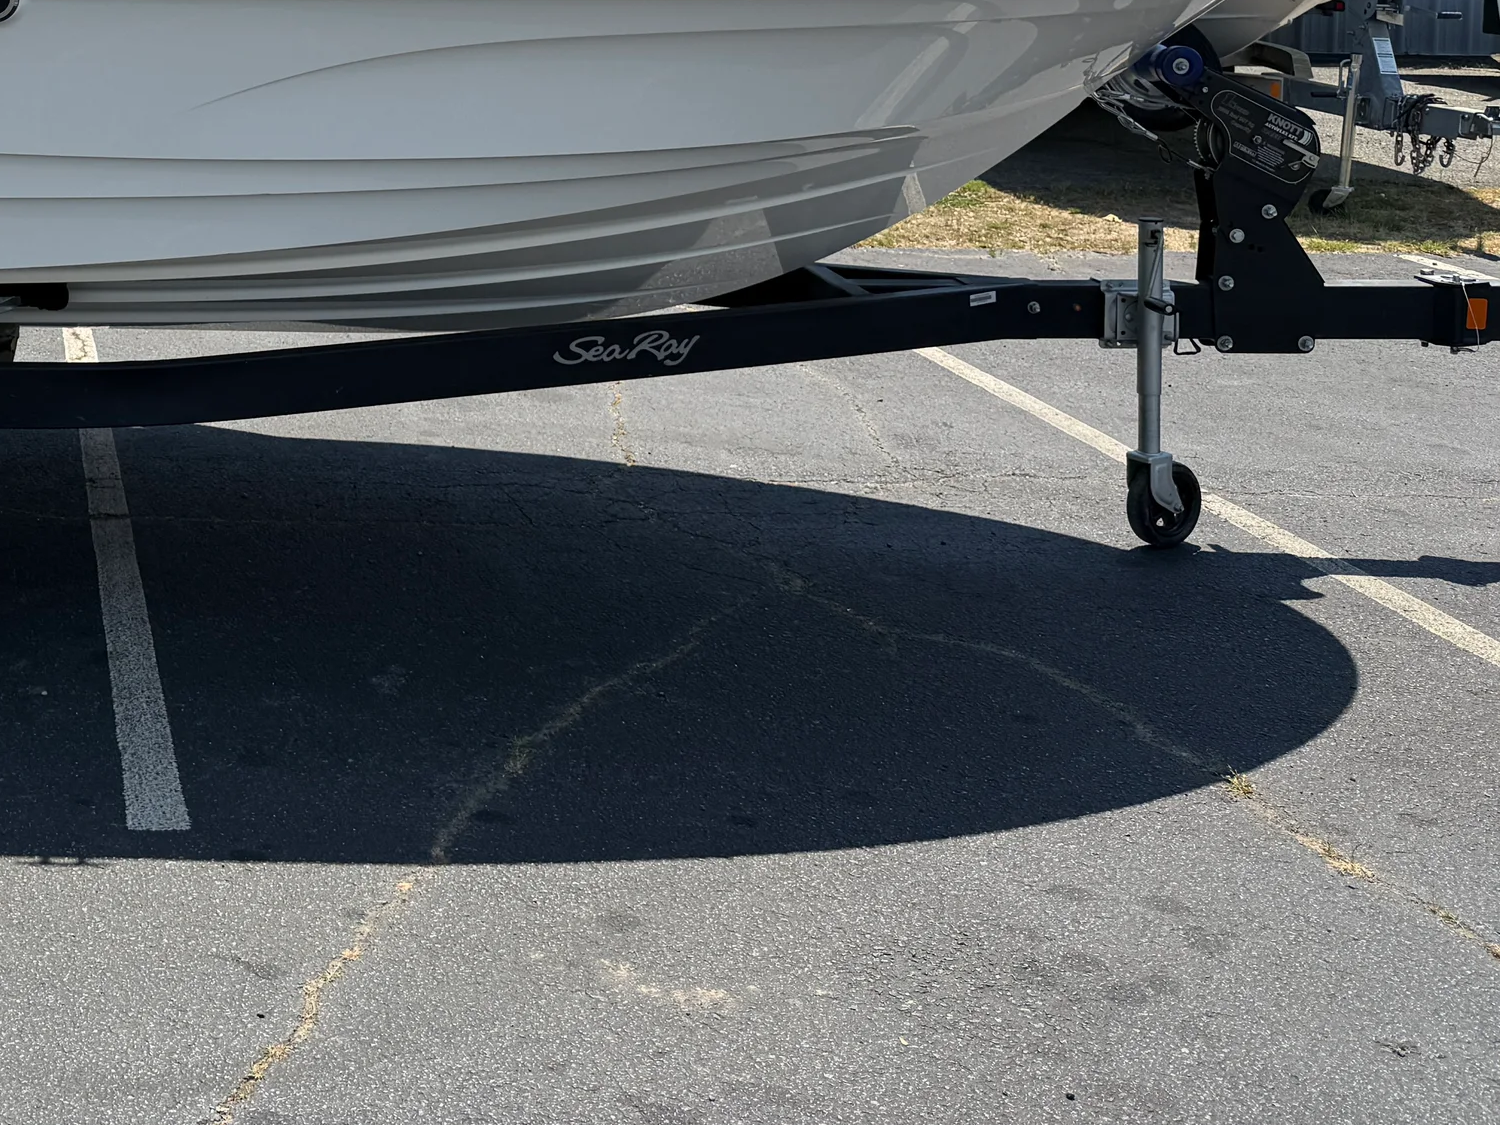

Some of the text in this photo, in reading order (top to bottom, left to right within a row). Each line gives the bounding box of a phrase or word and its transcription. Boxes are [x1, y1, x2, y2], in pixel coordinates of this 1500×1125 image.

[1267, 113, 1303, 135] KNOTT
[552, 330, 700, 366] Sea Ray
